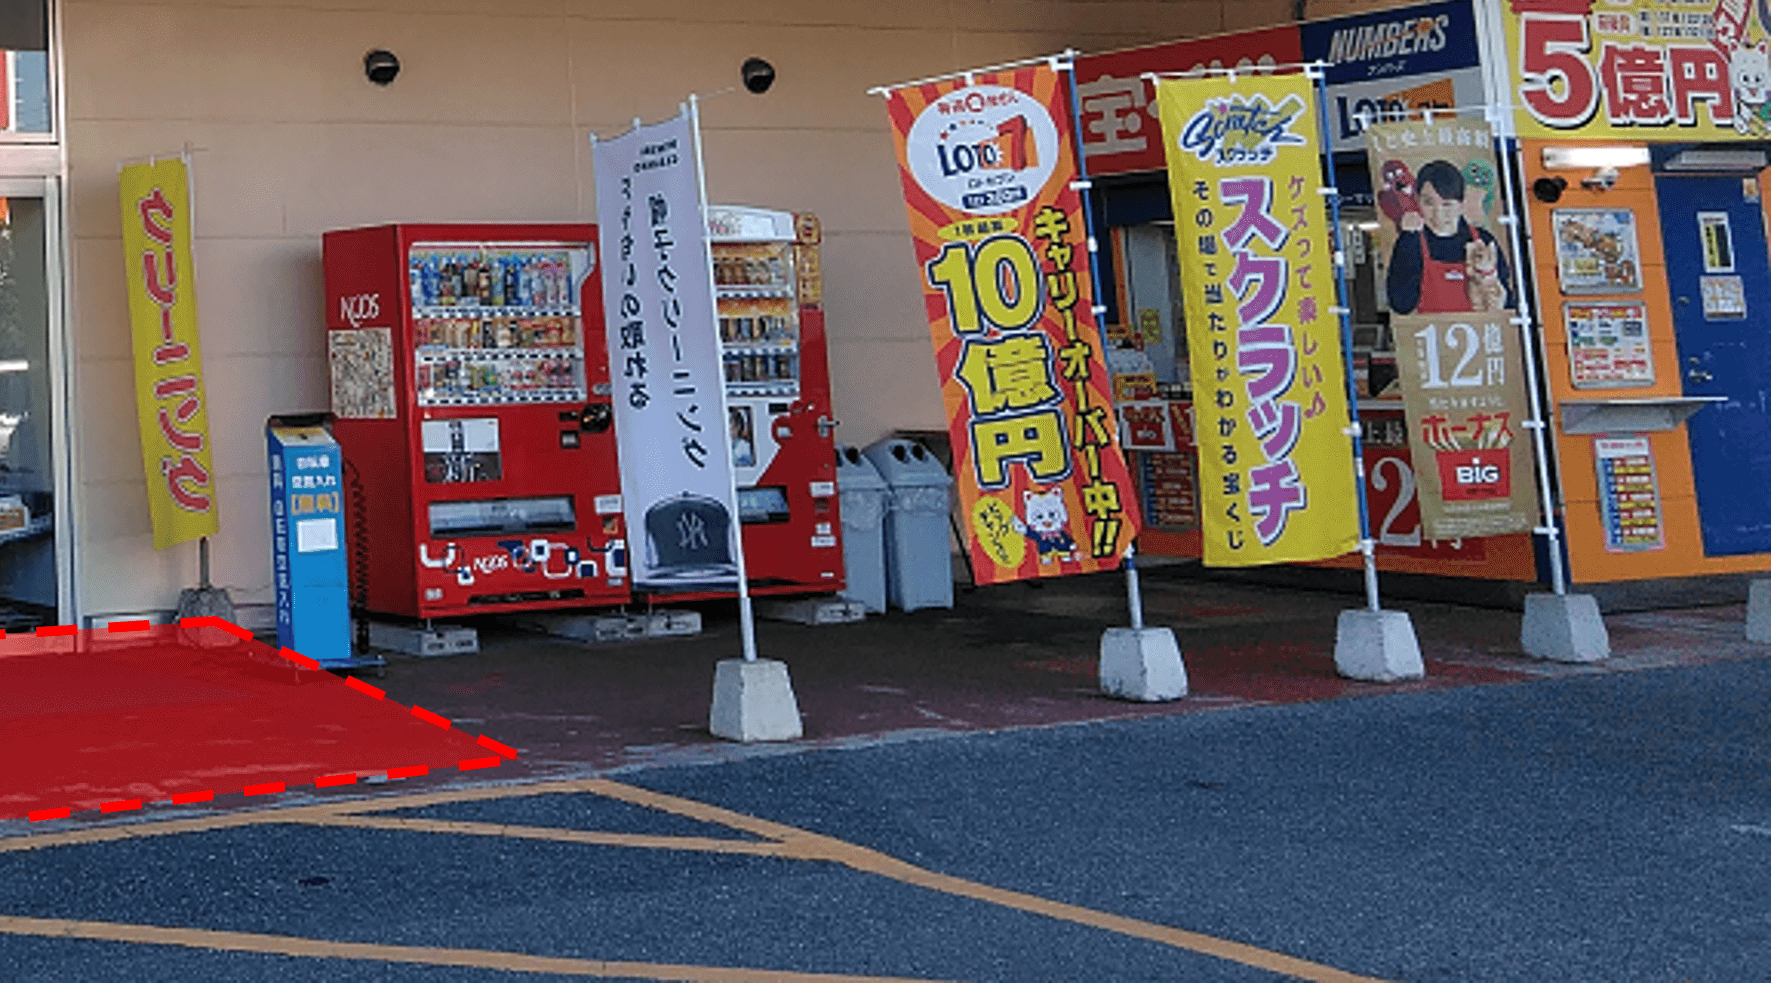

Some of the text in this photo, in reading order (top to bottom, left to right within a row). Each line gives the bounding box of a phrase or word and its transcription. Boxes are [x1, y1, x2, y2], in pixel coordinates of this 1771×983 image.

[1329, 15, 1449, 64] NUMBERS
[1518, 13, 1736, 128] 5億円
[1218, 176, 1308, 546] スクラッチ
[1414, 323, 1484, 389] 12
